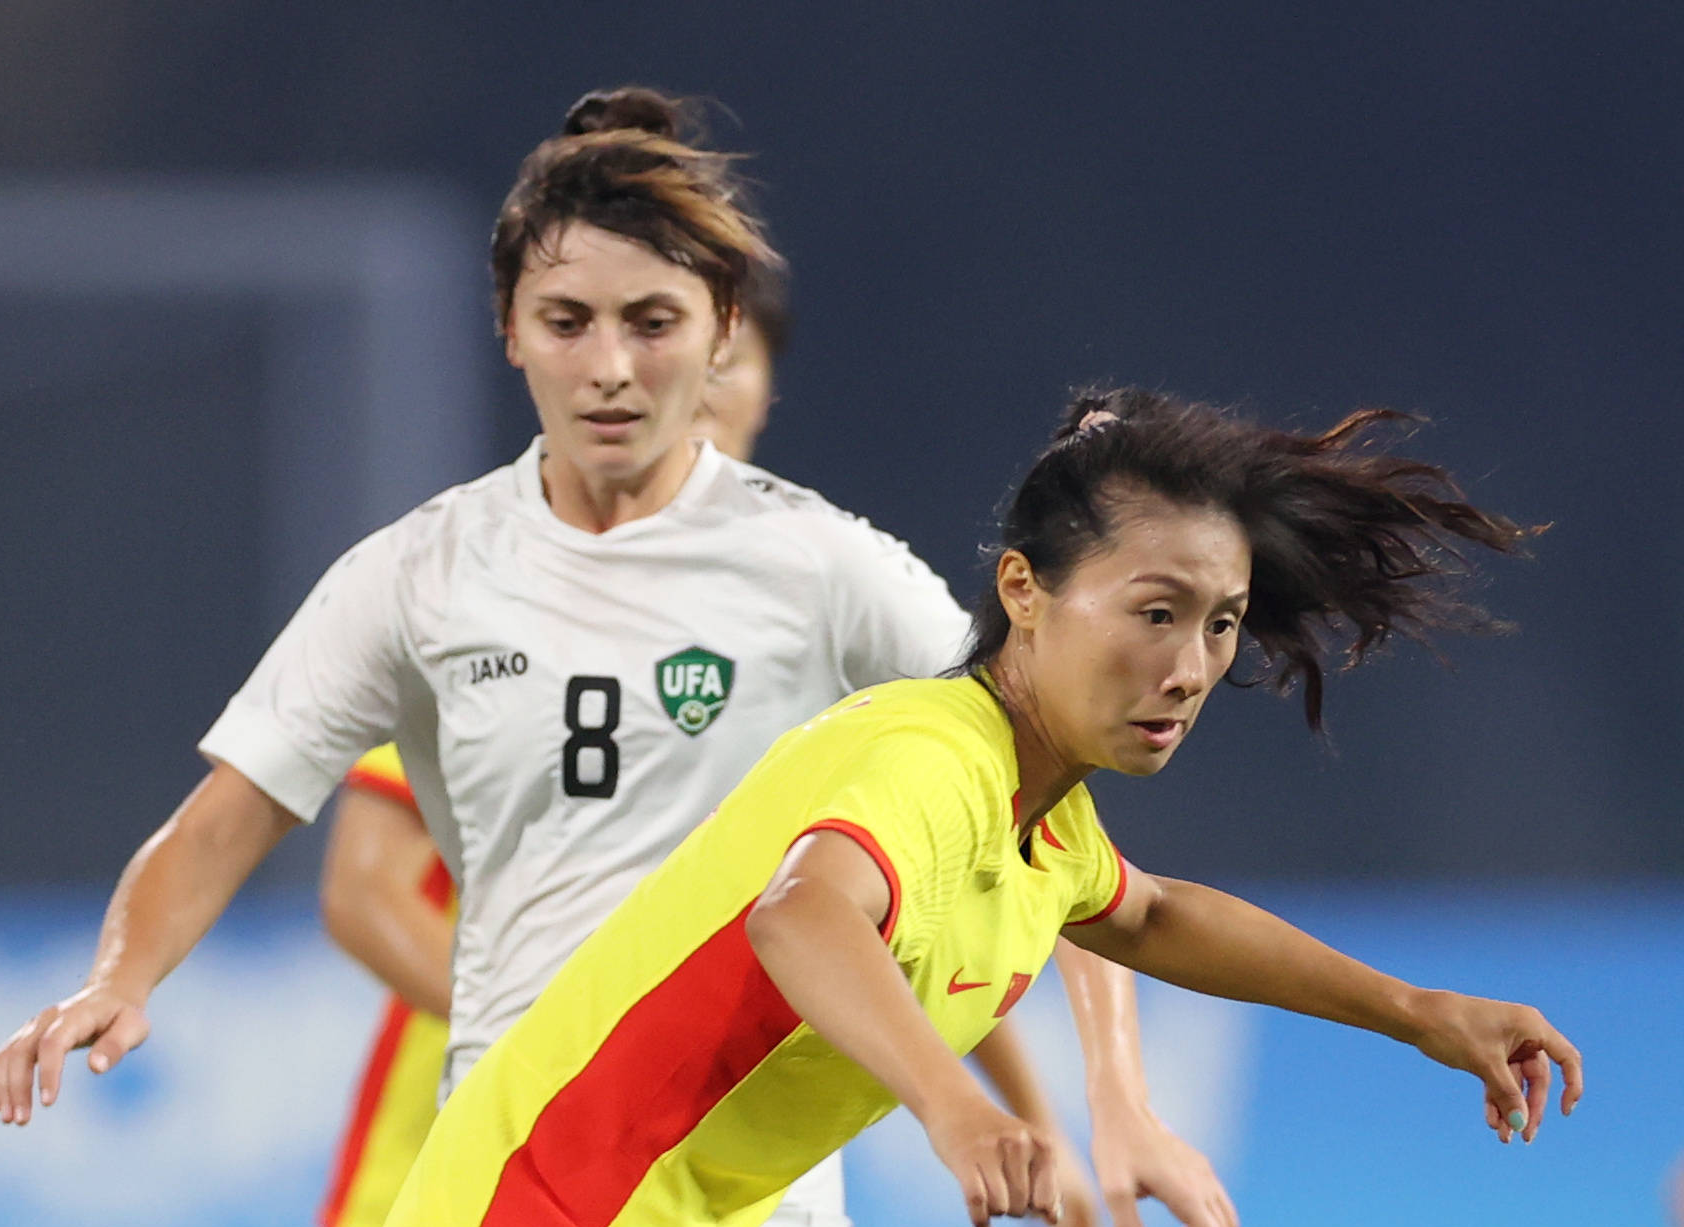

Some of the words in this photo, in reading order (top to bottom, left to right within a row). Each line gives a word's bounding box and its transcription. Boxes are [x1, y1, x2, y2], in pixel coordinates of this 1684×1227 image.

[470, 652, 528, 685] JAKO
[663, 664, 725, 698] UFA
[563, 675, 621, 799] 8
